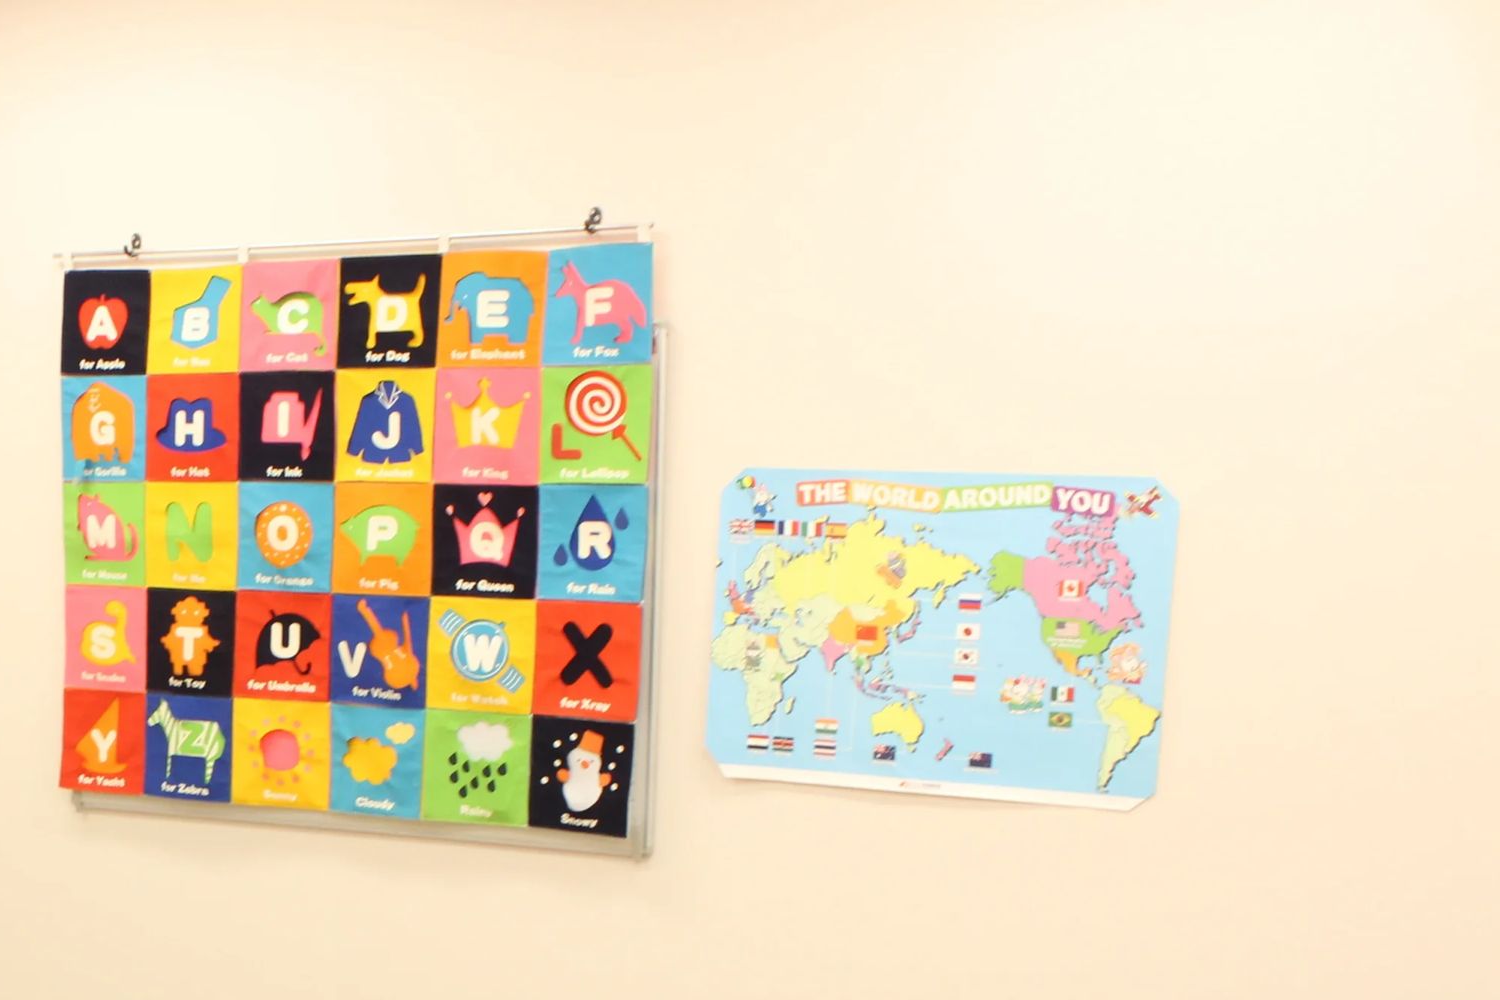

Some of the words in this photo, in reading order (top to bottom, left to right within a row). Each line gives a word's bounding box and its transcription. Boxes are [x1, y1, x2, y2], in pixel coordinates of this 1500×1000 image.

[86, 305, 118, 341] A
[277, 299, 309, 334] C
[376, 296, 407, 332] D
[476, 290, 510, 328] E
[585, 287, 614, 326] F
[181, 307, 209, 341] B
[80, 359, 95, 370] for
[96, 358, 126, 370] Apple
[266, 352, 284, 363] for
[285, 352, 308, 362] Cat
[365, 351, 384, 362] for
[386, 350, 410, 362] Dog
[451, 349, 469, 360] for
[572, 346, 593, 358] for
[594, 345, 619, 357] Fox
[90, 411, 116, 445] G
[174, 410, 205, 447] H
[277, 401, 289, 437] I
[371, 411, 401, 450] J
[471, 406, 500, 445] K
[552, 424, 581, 459] L
[170, 466, 187, 477] for
[188, 466, 211, 478] Hat
[266, 466, 283, 477] for
[284, 466, 303, 477] Ink
[462, 467, 480, 478] for
[482, 467, 508, 480] King
[560, 467, 579, 478] for
[581, 466, 629, 479] Lollipop
[799, 482, 847, 503] THE
[851, 483, 940, 510] WORLD
[943, 484, 1050, 509] AROUND
[1055, 487, 1111, 515] YOU
[86, 514, 116, 548] M
[166, 502, 213, 562] N
[266, 516, 299, 551] O
[366, 515, 398, 551] P
[470, 521, 504, 561] Q
[577, 521, 612, 559] R
[82, 569, 96, 578] for
[255, 572, 273, 584] for
[359, 577, 377, 588] for
[378, 578, 399, 591] Pig
[455, 579, 476, 590] for
[477, 579, 515, 592] Queen
[566, 582, 587, 594] for
[588, 583, 616, 595] Rain
[90, 625, 117, 659] S
[175, 626, 203, 661] T
[270, 622, 301, 659] U
[463, 634, 501, 672] W
[560, 621, 613, 688] X
[338, 640, 367, 678] V
[169, 676, 184, 687] for
[184, 678, 207, 690] Toy
[247, 679, 266, 690] for
[267, 680, 317, 693] Umbrella
[352, 686, 370, 697] for
[370, 687, 401, 700] Violin
[451, 692, 468, 703] for
[559, 697, 580, 709] for
[581, 698, 612, 713] Xray
[90, 728, 117, 763] Y
[179, 722, 205, 754] Z
[77, 773, 95, 785] for
[96, 776, 126, 788] Yacht
[161, 781, 177, 792] for
[177, 783, 210, 796] Zebra
[355, 797, 395, 811] Cloudy
[460, 804, 494, 818] Rainy
[560, 813, 598, 829] Snowy
